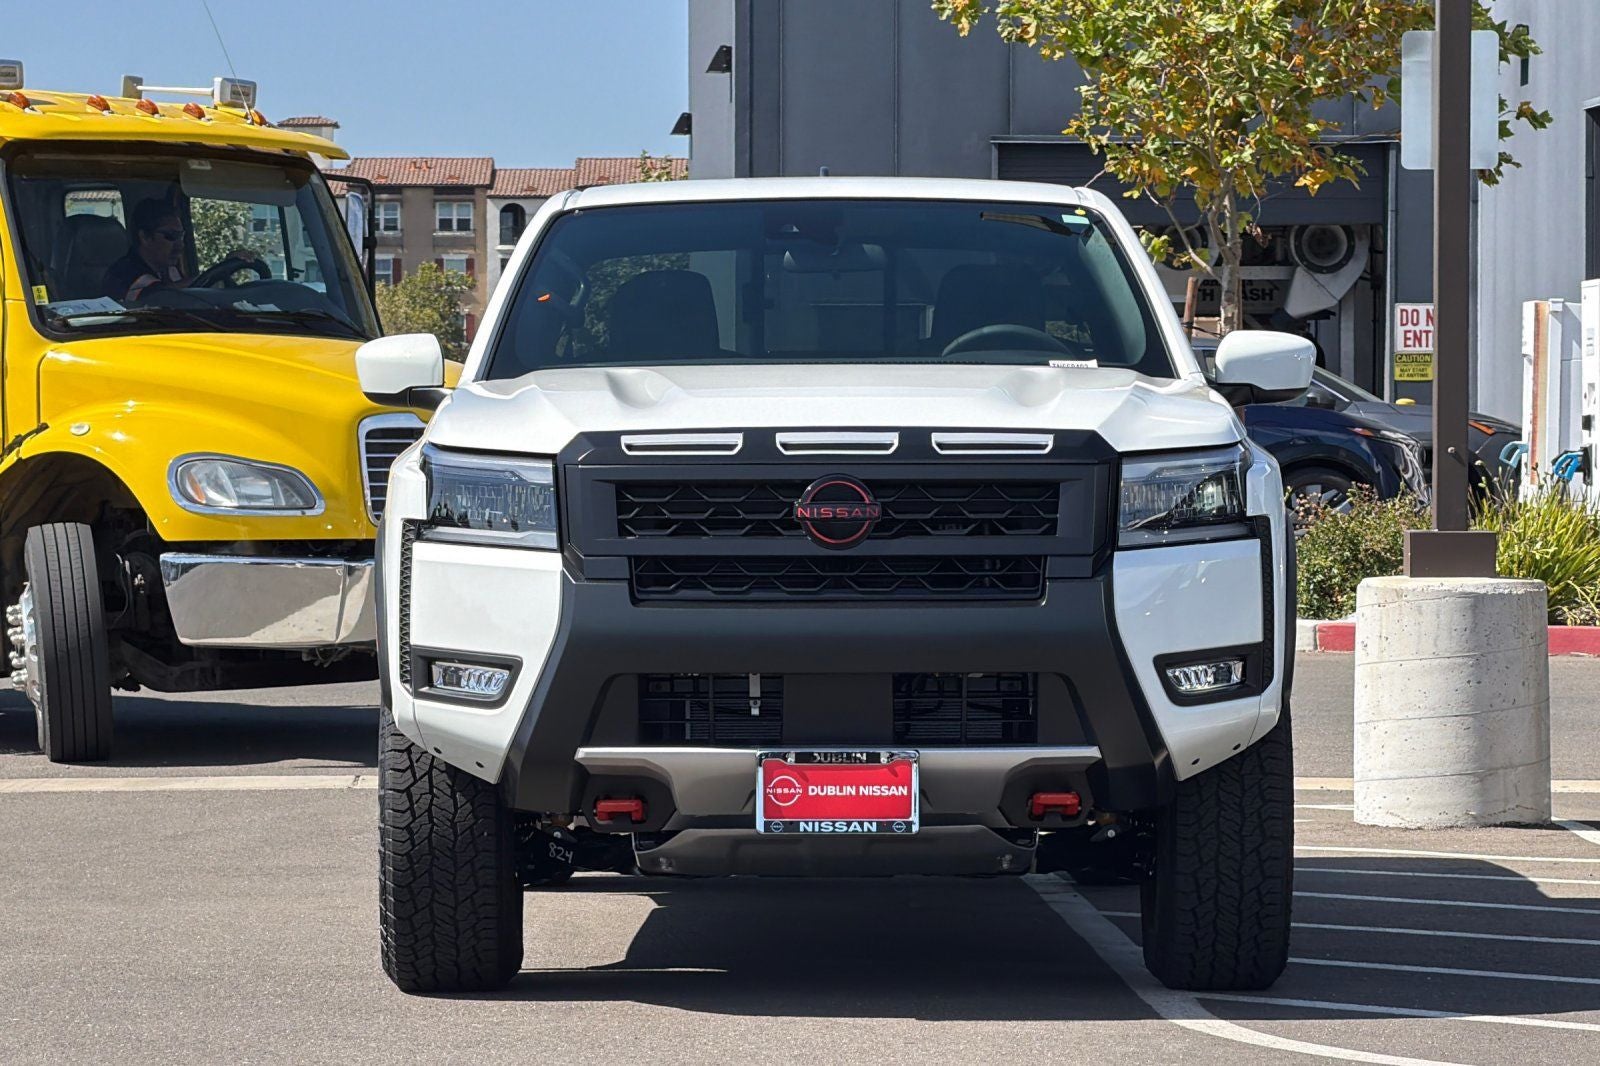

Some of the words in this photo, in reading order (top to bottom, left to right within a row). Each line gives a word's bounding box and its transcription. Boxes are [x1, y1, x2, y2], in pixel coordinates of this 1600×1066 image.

[1400, 308, 1420, 327] DO
[1403, 329, 1433, 348] ENT
[1396, 354, 1431, 362] CAUTION
[797, 507, 879, 518] NISSAN
[811, 752, 867, 764] DUBLIN
[808, 785, 856, 796] DUBLIN
[859, 785, 908, 796] NISSAN
[800, 821, 877, 832] NISSAN
[548, 841, 574, 864] 824
